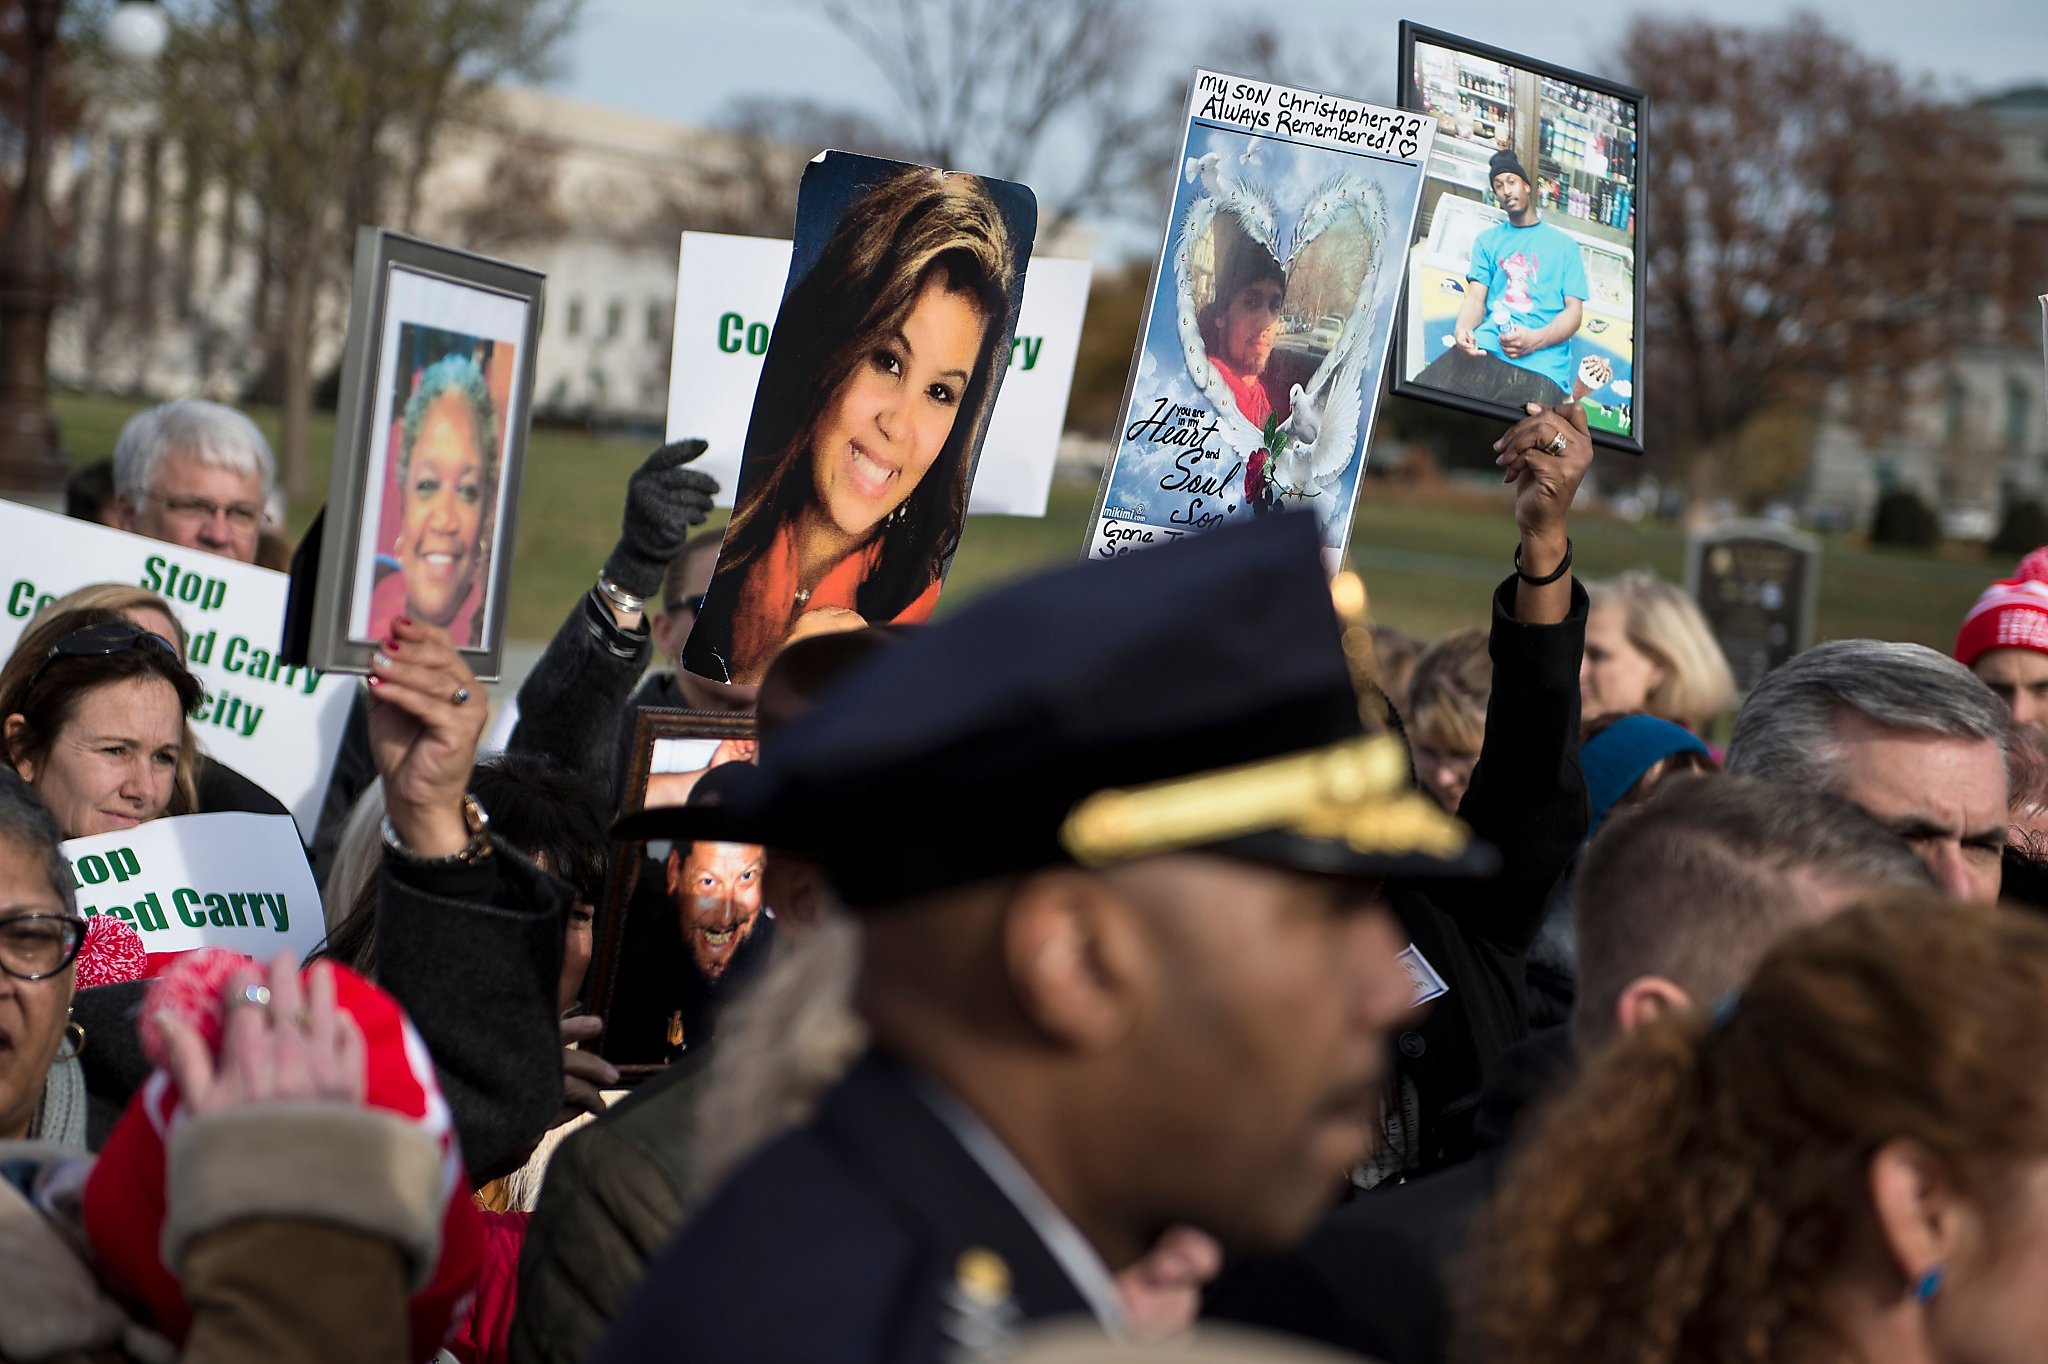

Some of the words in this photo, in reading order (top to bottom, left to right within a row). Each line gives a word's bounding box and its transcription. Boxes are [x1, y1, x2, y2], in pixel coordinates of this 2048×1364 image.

[1278, 92, 1391, 131] Christopher
[1126, 397, 1219, 448] Heart
[1175, 405, 1191, 418] you
[1191, 408, 1206, 418] are
[1178, 415, 1186, 426] in
[1187, 418, 1200, 428] my
[1204, 448, 1220, 460] and
[1159, 448, 1242, 499] Soul
[1103, 519, 1154, 543] Gone
[1169, 497, 1225, 530] Son
[140, 555, 227, 610] Stop
[171, 887, 290, 933] Carry
